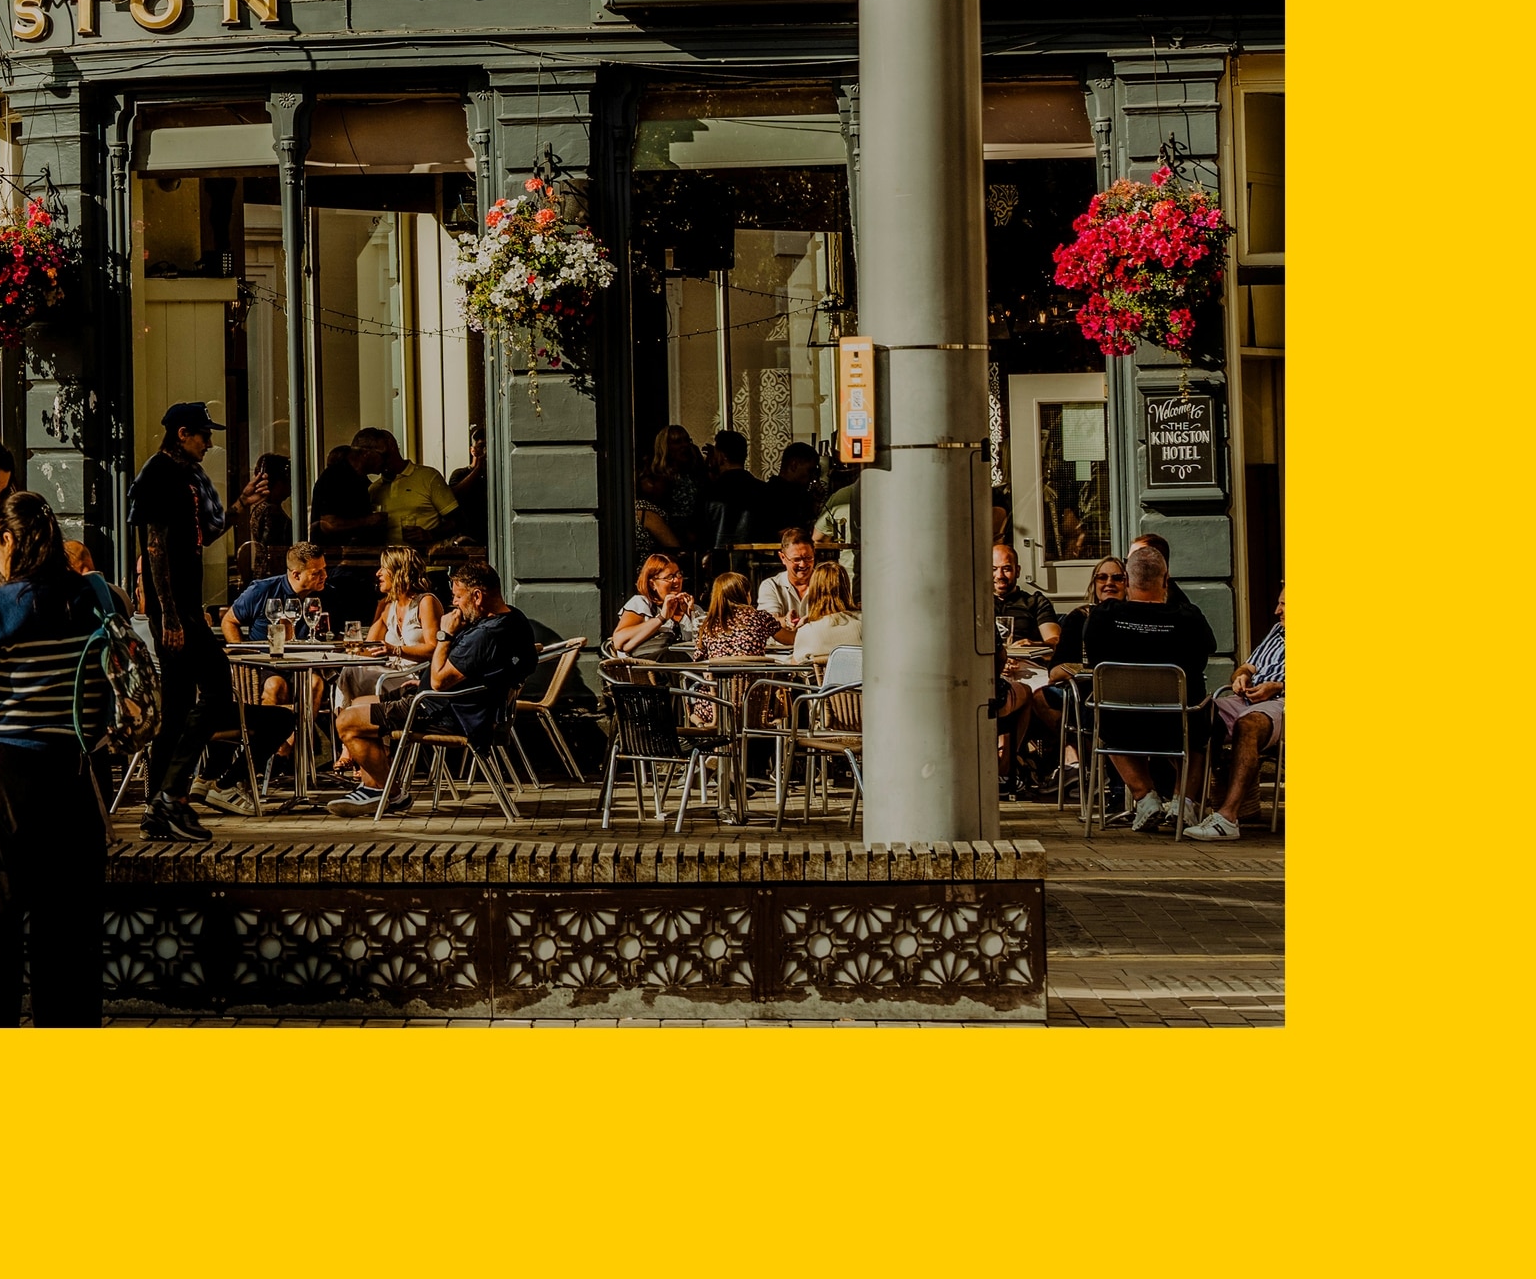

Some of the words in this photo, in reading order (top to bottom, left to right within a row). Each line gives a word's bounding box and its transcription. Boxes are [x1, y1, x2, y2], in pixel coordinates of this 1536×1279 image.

[1149, 398, 1191, 423] Welcome
[1190, 404, 1206, 420] to
[1168, 422, 1189, 430] THE
[1150, 430, 1210, 446] KINGSTON
[1162, 445, 1202, 461] HOTEL
